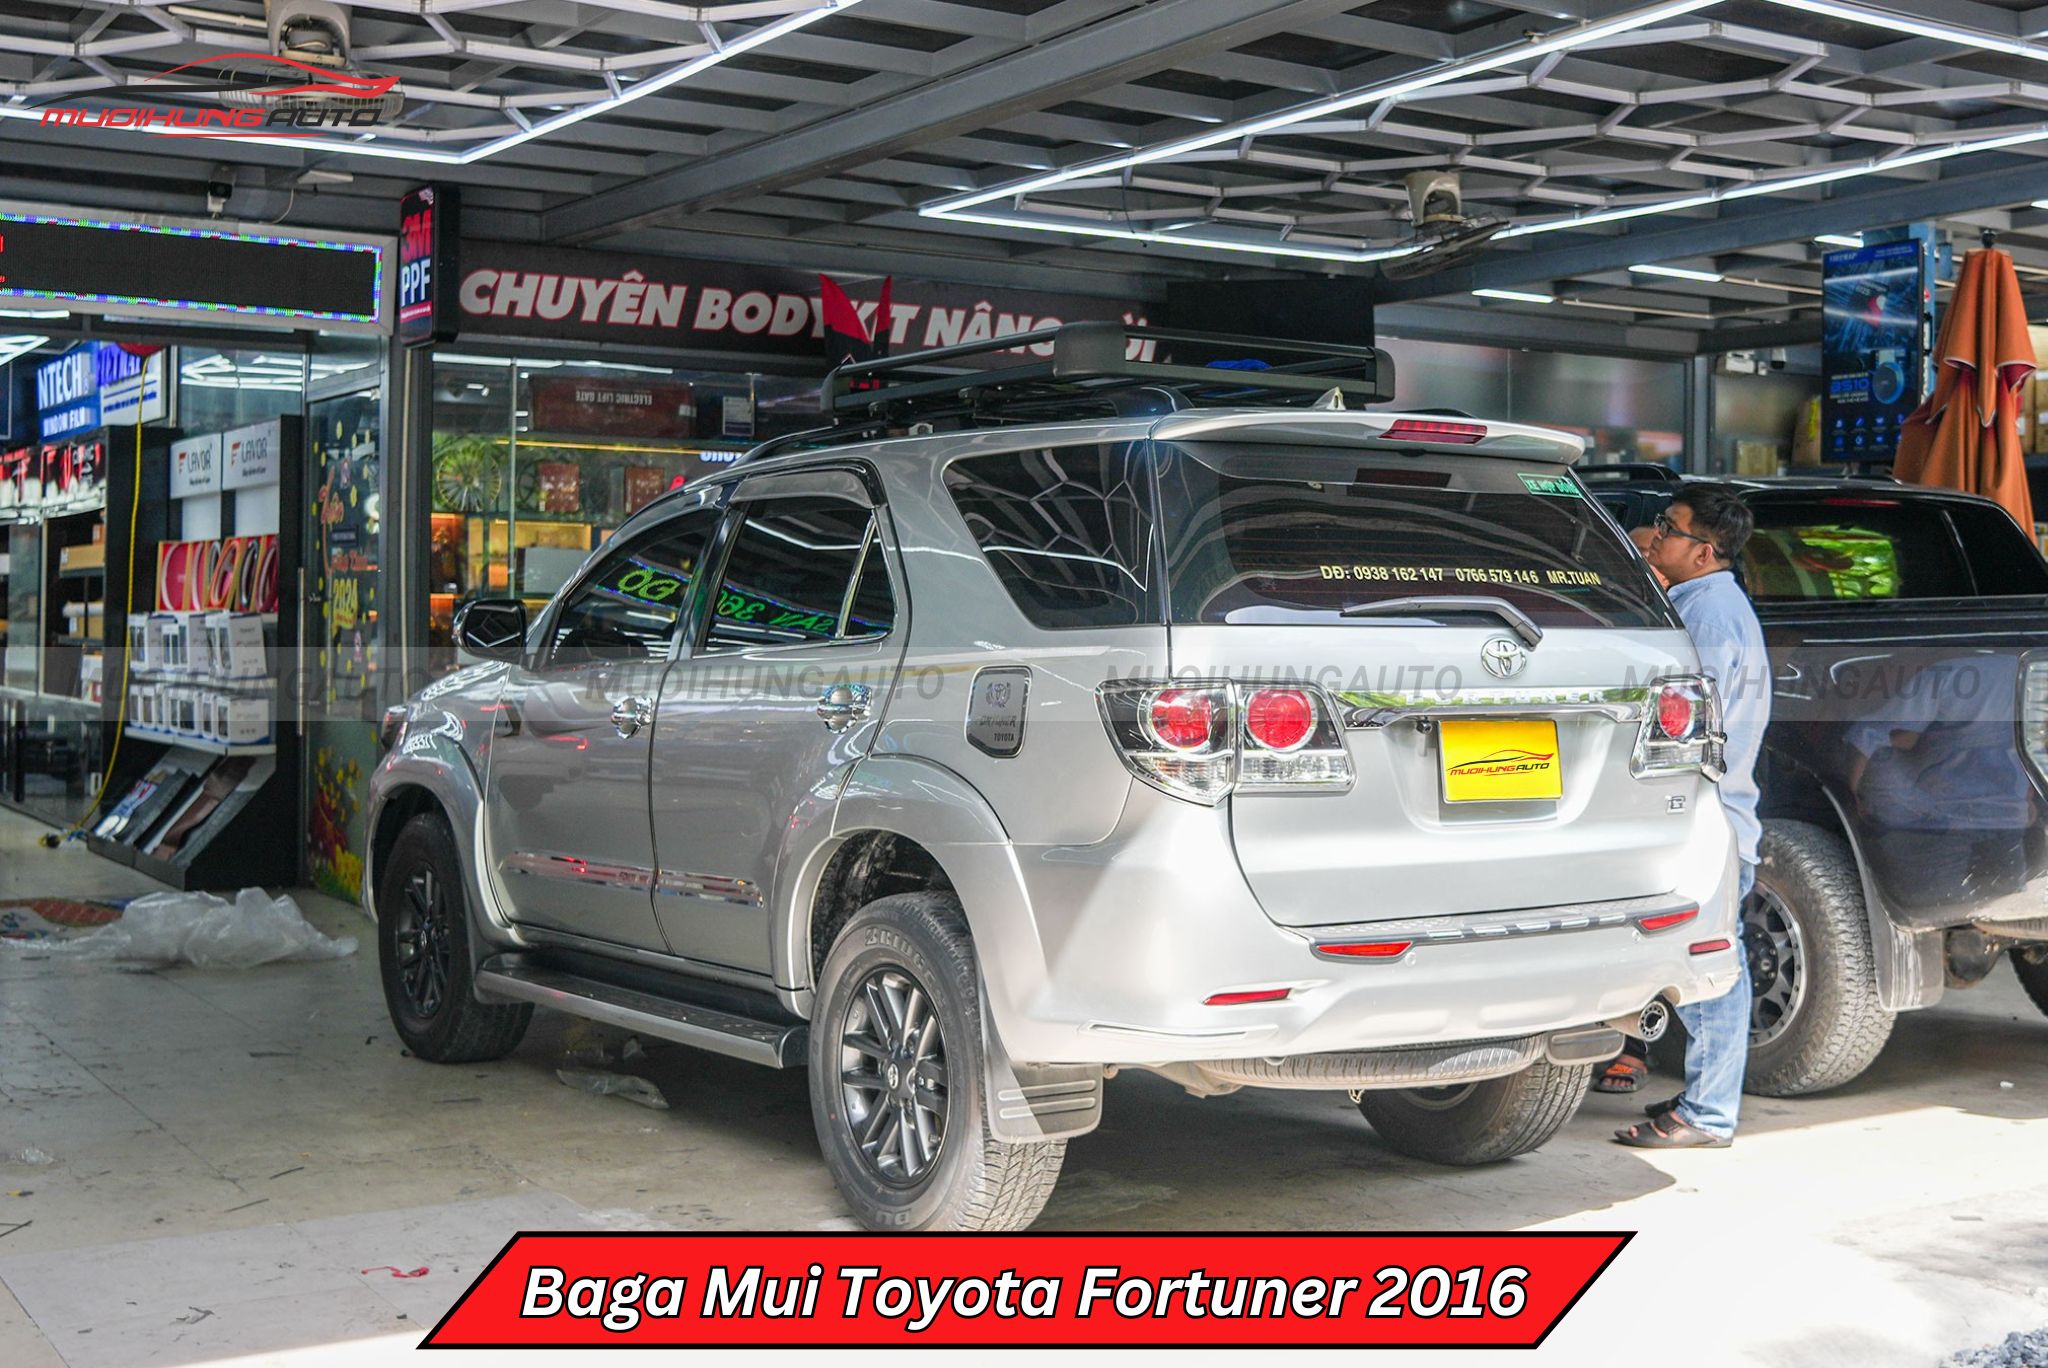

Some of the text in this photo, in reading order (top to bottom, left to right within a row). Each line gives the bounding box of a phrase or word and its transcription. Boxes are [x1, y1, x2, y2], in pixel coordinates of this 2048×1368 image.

[401, 209, 433, 262] 3M
[401, 258, 431, 307] PPF
[459, 268, 689, 328] CHUYÊN
[575, 389, 653, 406] ELECTRIC LIFT GATE
[1353, 565, 1389, 581] 0938
[1391, 567, 1418, 582] 162
[1420, 567, 1444, 582] 147
[1455, 568, 1487, 583] 0766
[1488, 568, 1512, 584] 579
[1513, 569, 1540, 585] 146
